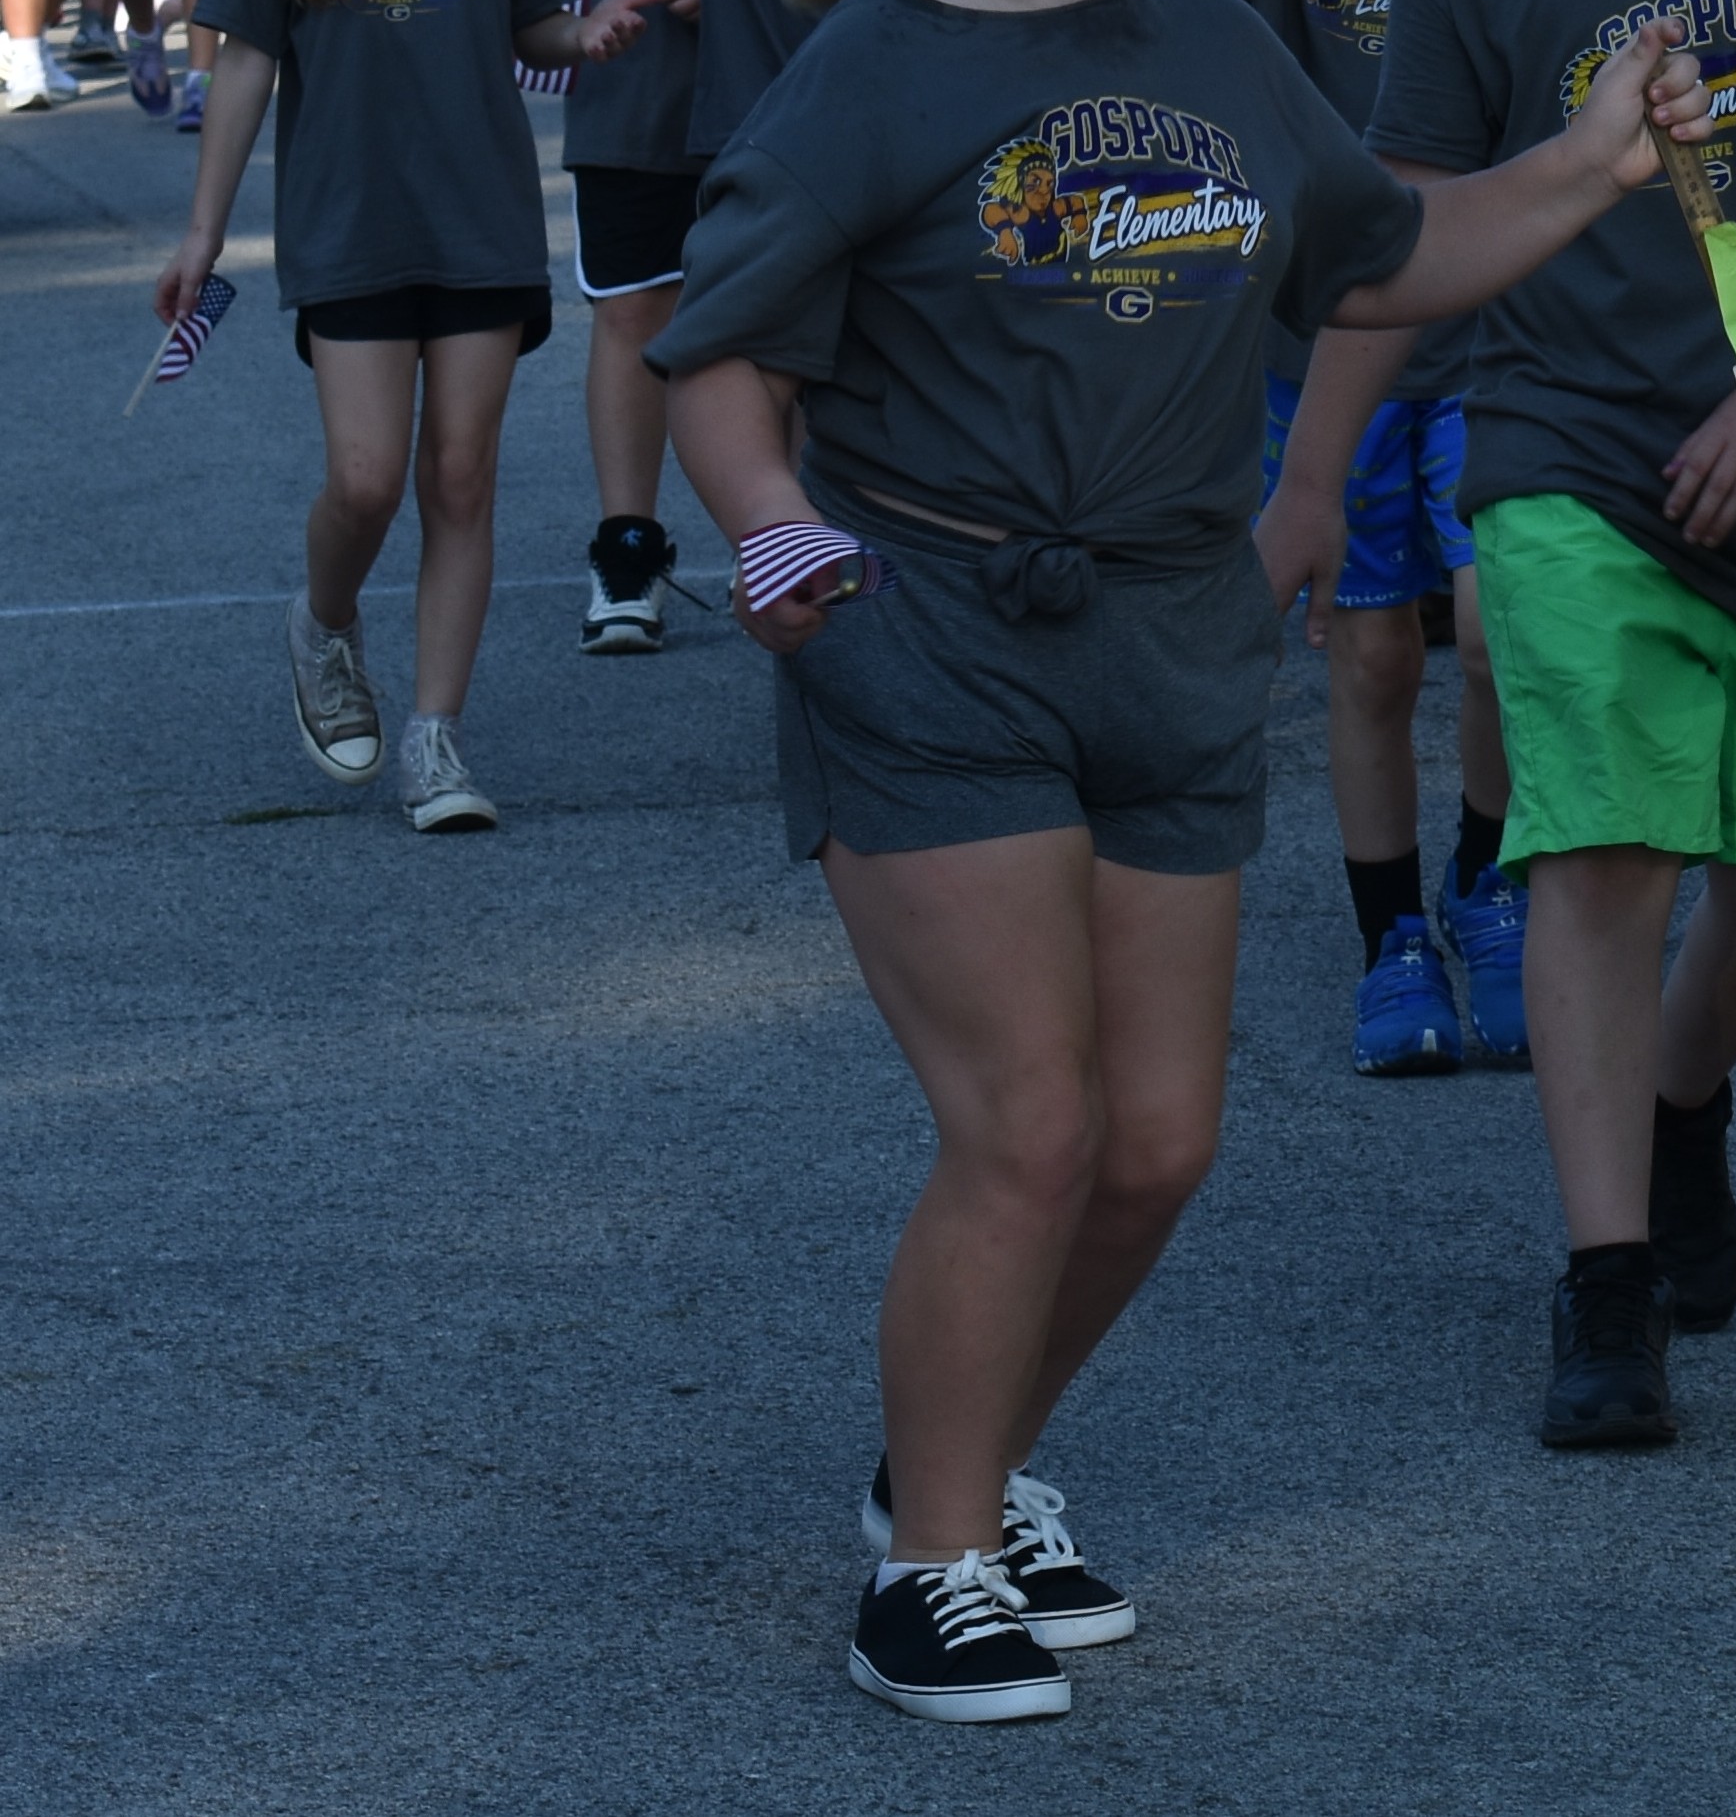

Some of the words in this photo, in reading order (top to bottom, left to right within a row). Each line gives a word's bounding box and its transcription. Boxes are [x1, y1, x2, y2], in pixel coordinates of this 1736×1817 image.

[1040, 96, 1249, 189] GOSPORT
[1088, 178, 1267, 261] Elementary
[1090, 269, 1161, 285] ACHIEVE
[1106, 286, 1153, 322] G
